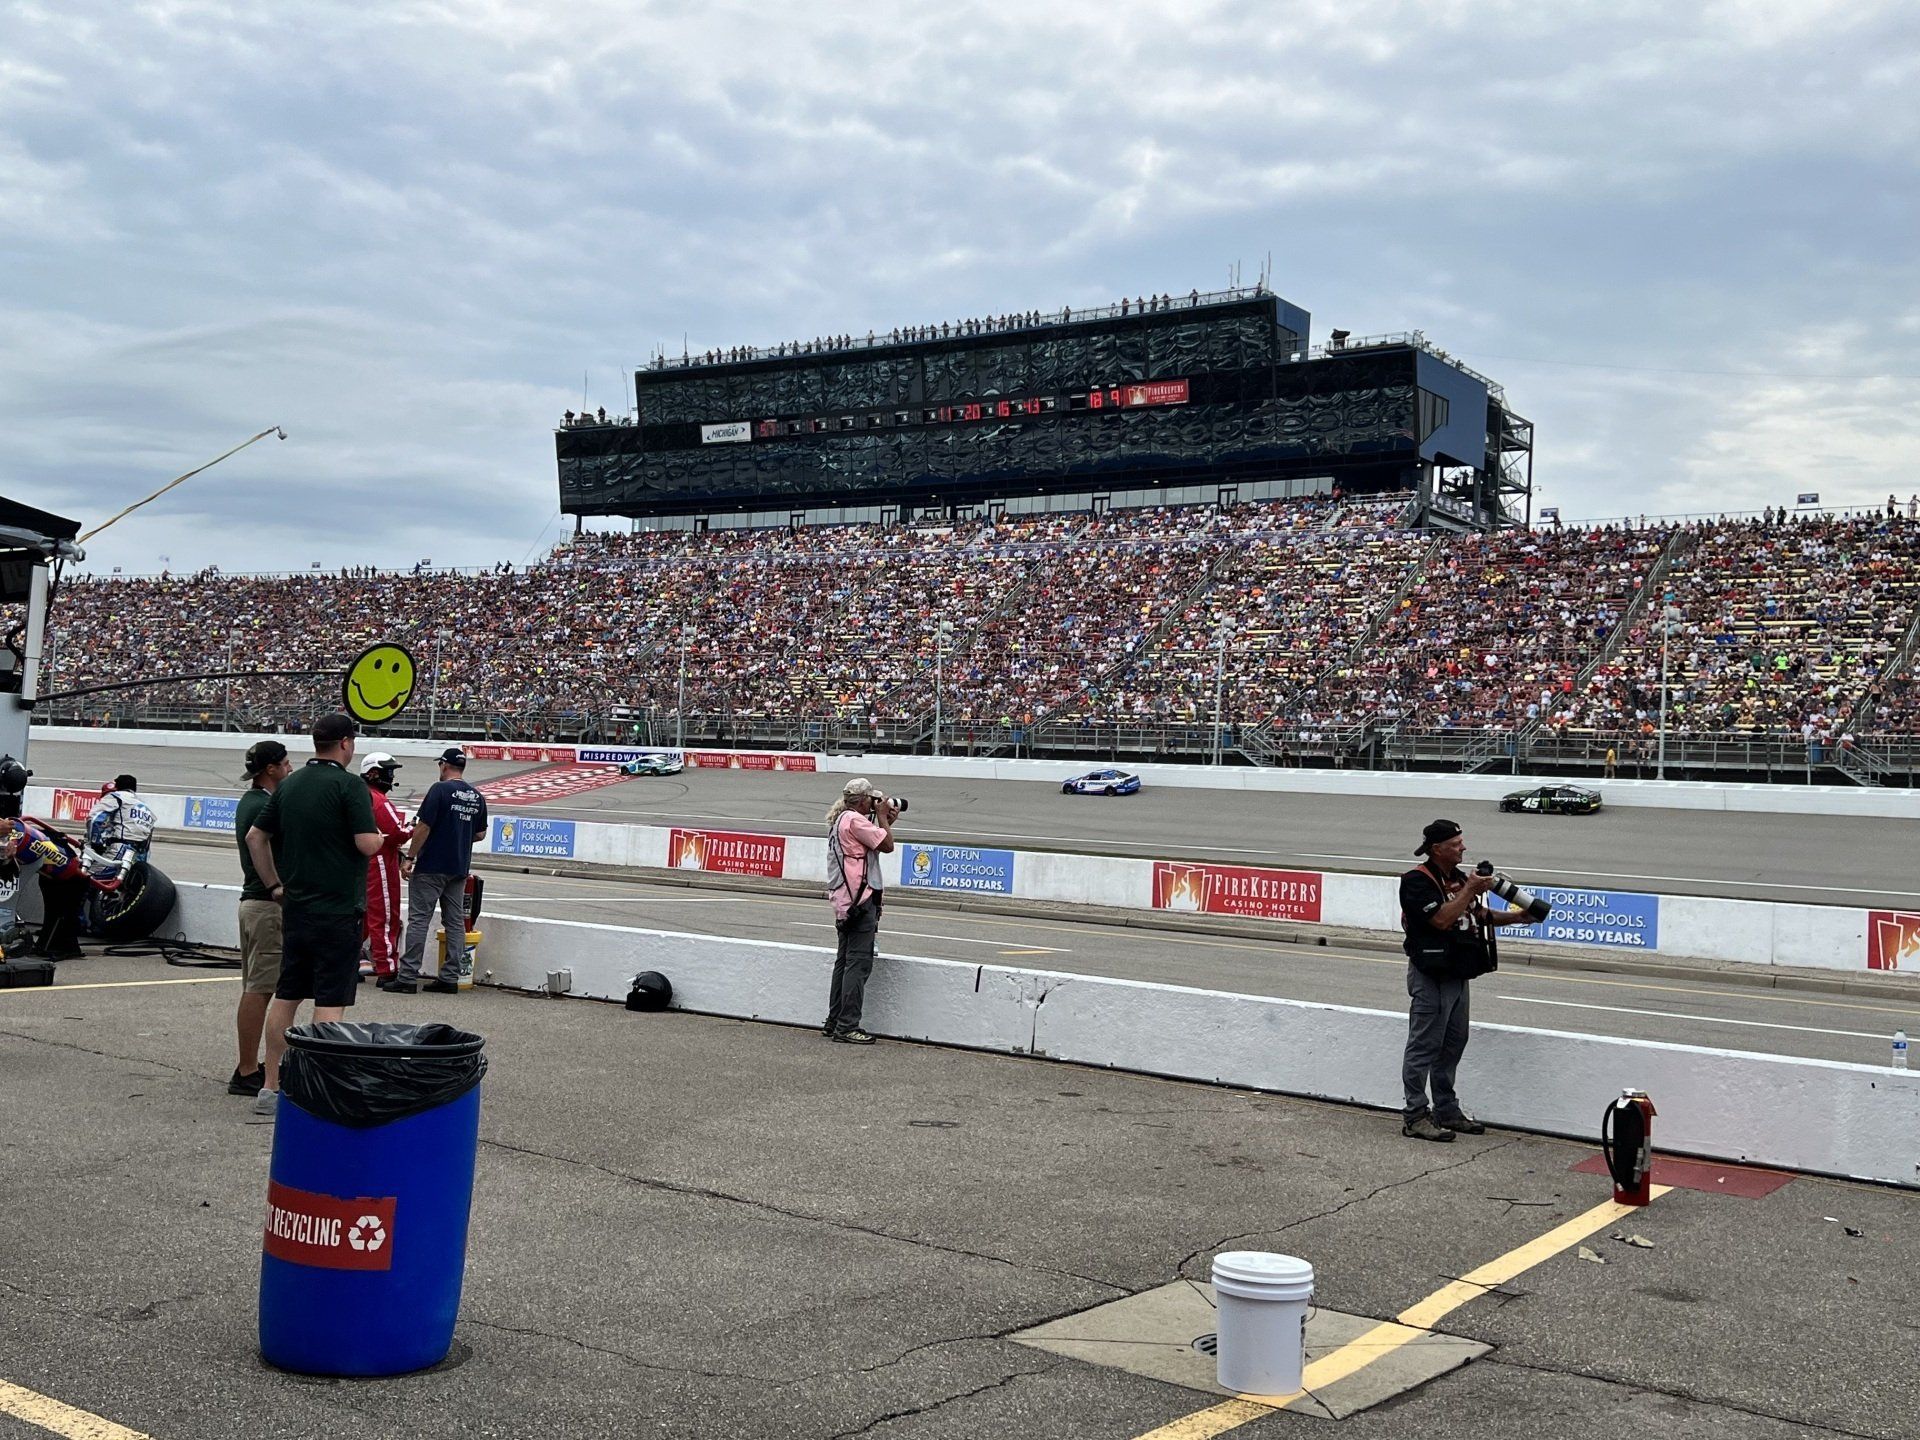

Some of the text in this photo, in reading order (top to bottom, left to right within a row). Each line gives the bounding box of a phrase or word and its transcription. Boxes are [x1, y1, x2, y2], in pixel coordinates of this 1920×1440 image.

[964, 404, 980, 420] 20
[998, 401, 1009, 417] 16
[1024, 398, 1039, 414] 43
[1522, 797, 1540, 809] 45
[205, 819, 216, 827] FOR
[522, 820, 536, 830] FOR
[521, 832, 569, 844] FOR SCHOOLS.
[30, 841, 67, 867] SUNOCO
[520, 844, 568, 855] FOR 50 YEARS.
[942, 848, 960, 860] FOR
[717, 859, 773, 871] CASINO HOTEL
[941, 862, 1006, 877] FOR SCHOOLS.
[909, 877, 933, 886] LOTTERY
[940, 876, 1005, 891] FOR 50 YEARS.
[1223, 898, 1305, 914] CASINO HOTEL
[1549, 891, 1575, 905] FOR
[1577, 894, 1609, 908] FUN.
[1548, 909, 1647, 928] FOR SCHOOLS.
[1500, 927, 1536, 937] LOTTERY
[1548, 926, 1646, 946] FOR 50 YEARS.
[273, 1206, 342, 1247] RECYCLING
